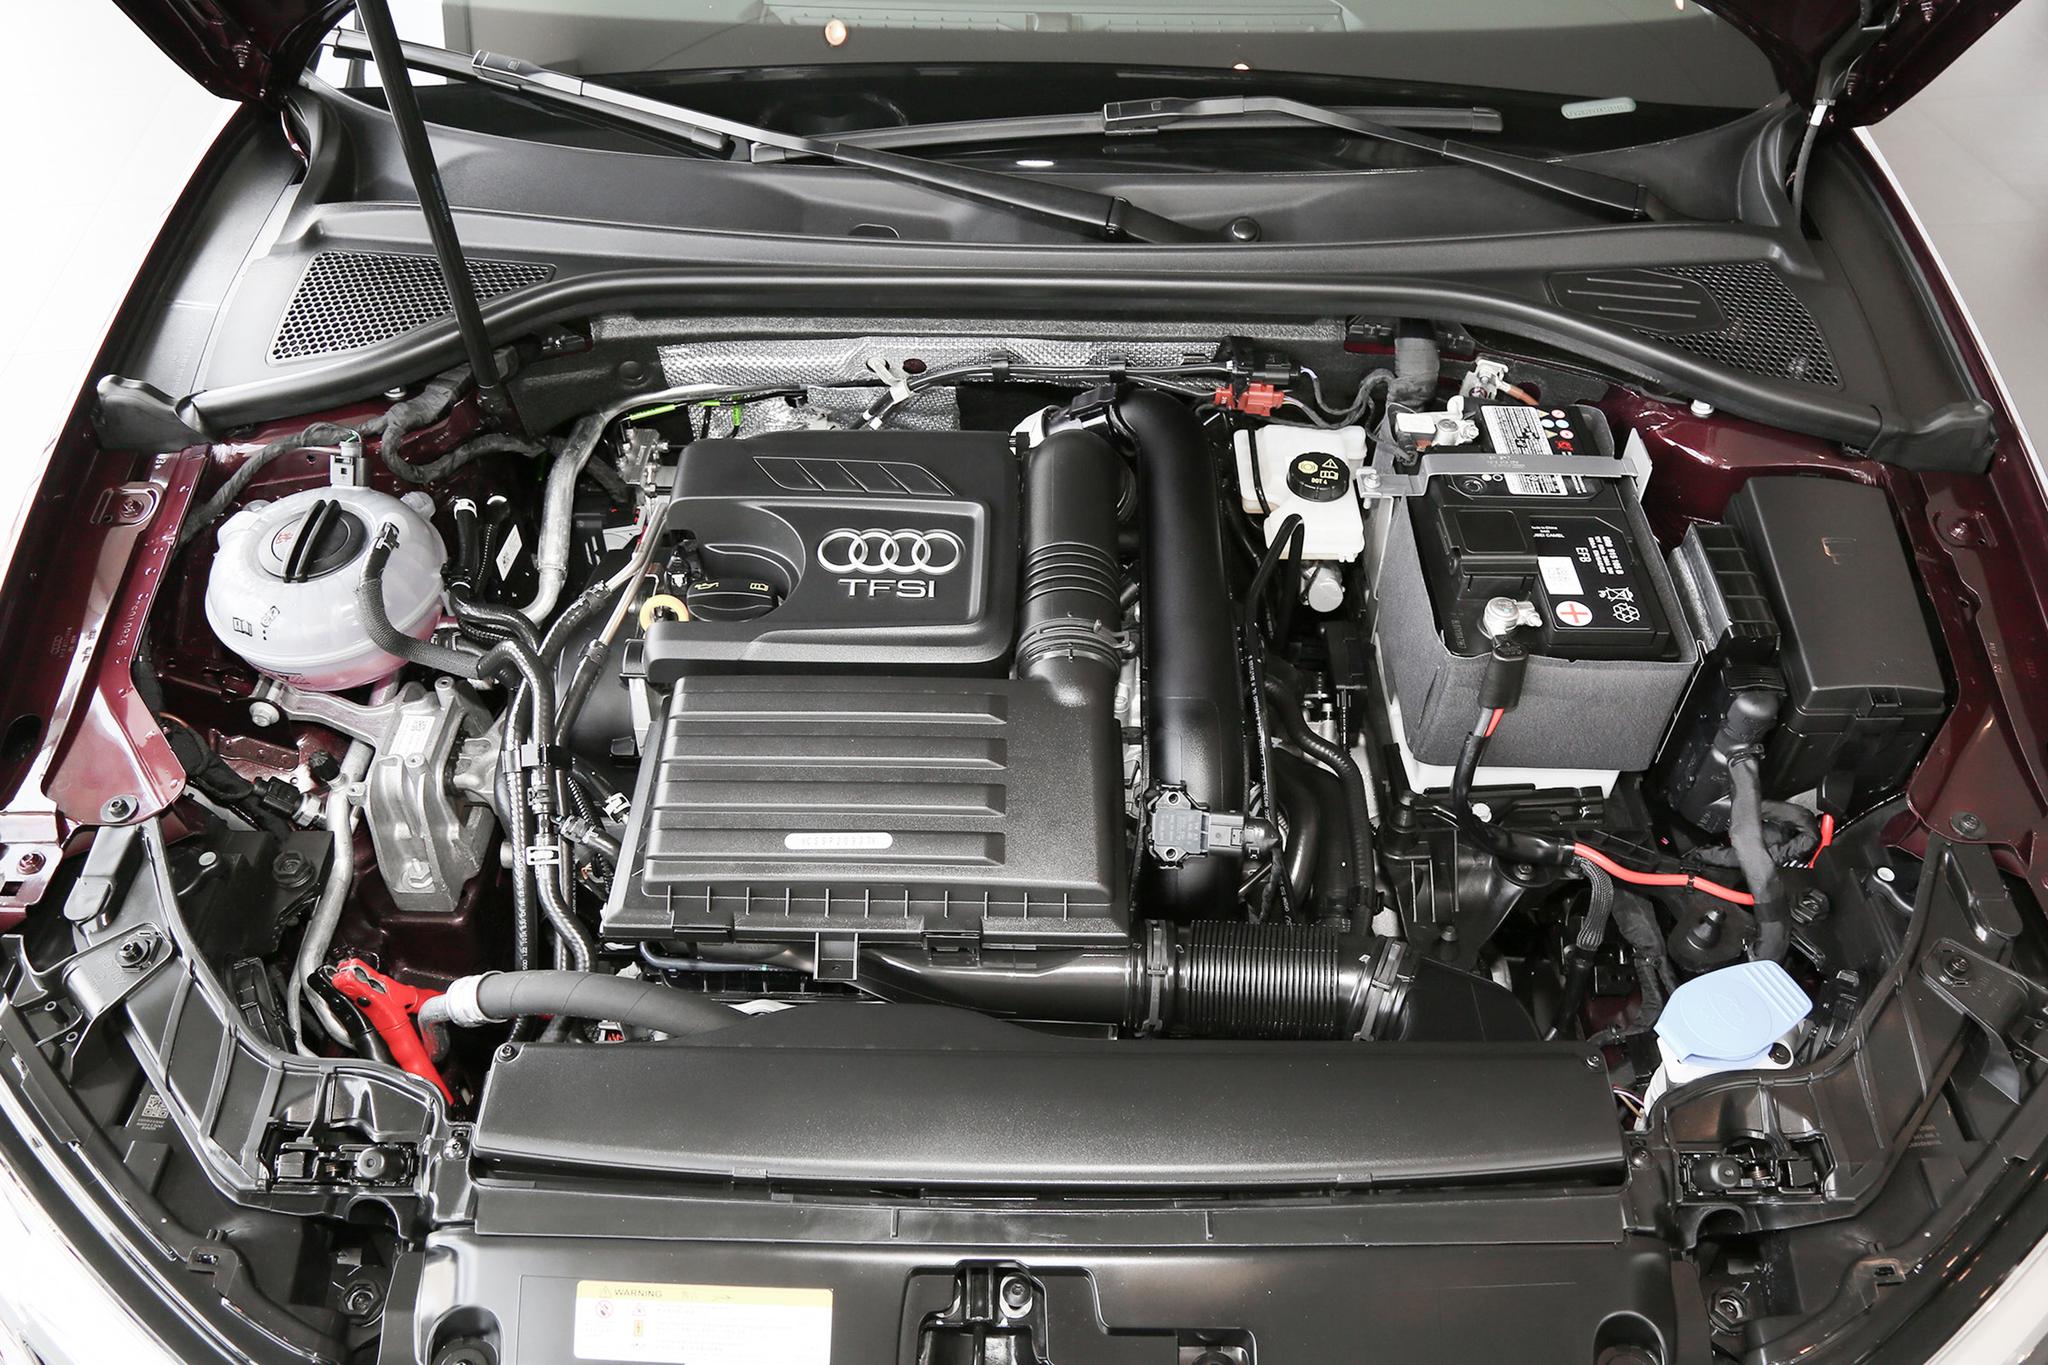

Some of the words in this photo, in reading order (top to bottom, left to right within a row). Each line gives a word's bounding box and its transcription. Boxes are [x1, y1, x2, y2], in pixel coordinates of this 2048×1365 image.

[1575, 547, 1592, 563] EFB
[838, 578, 936, 599] TFSI
[614, 1288, 663, 1298] WARNING
